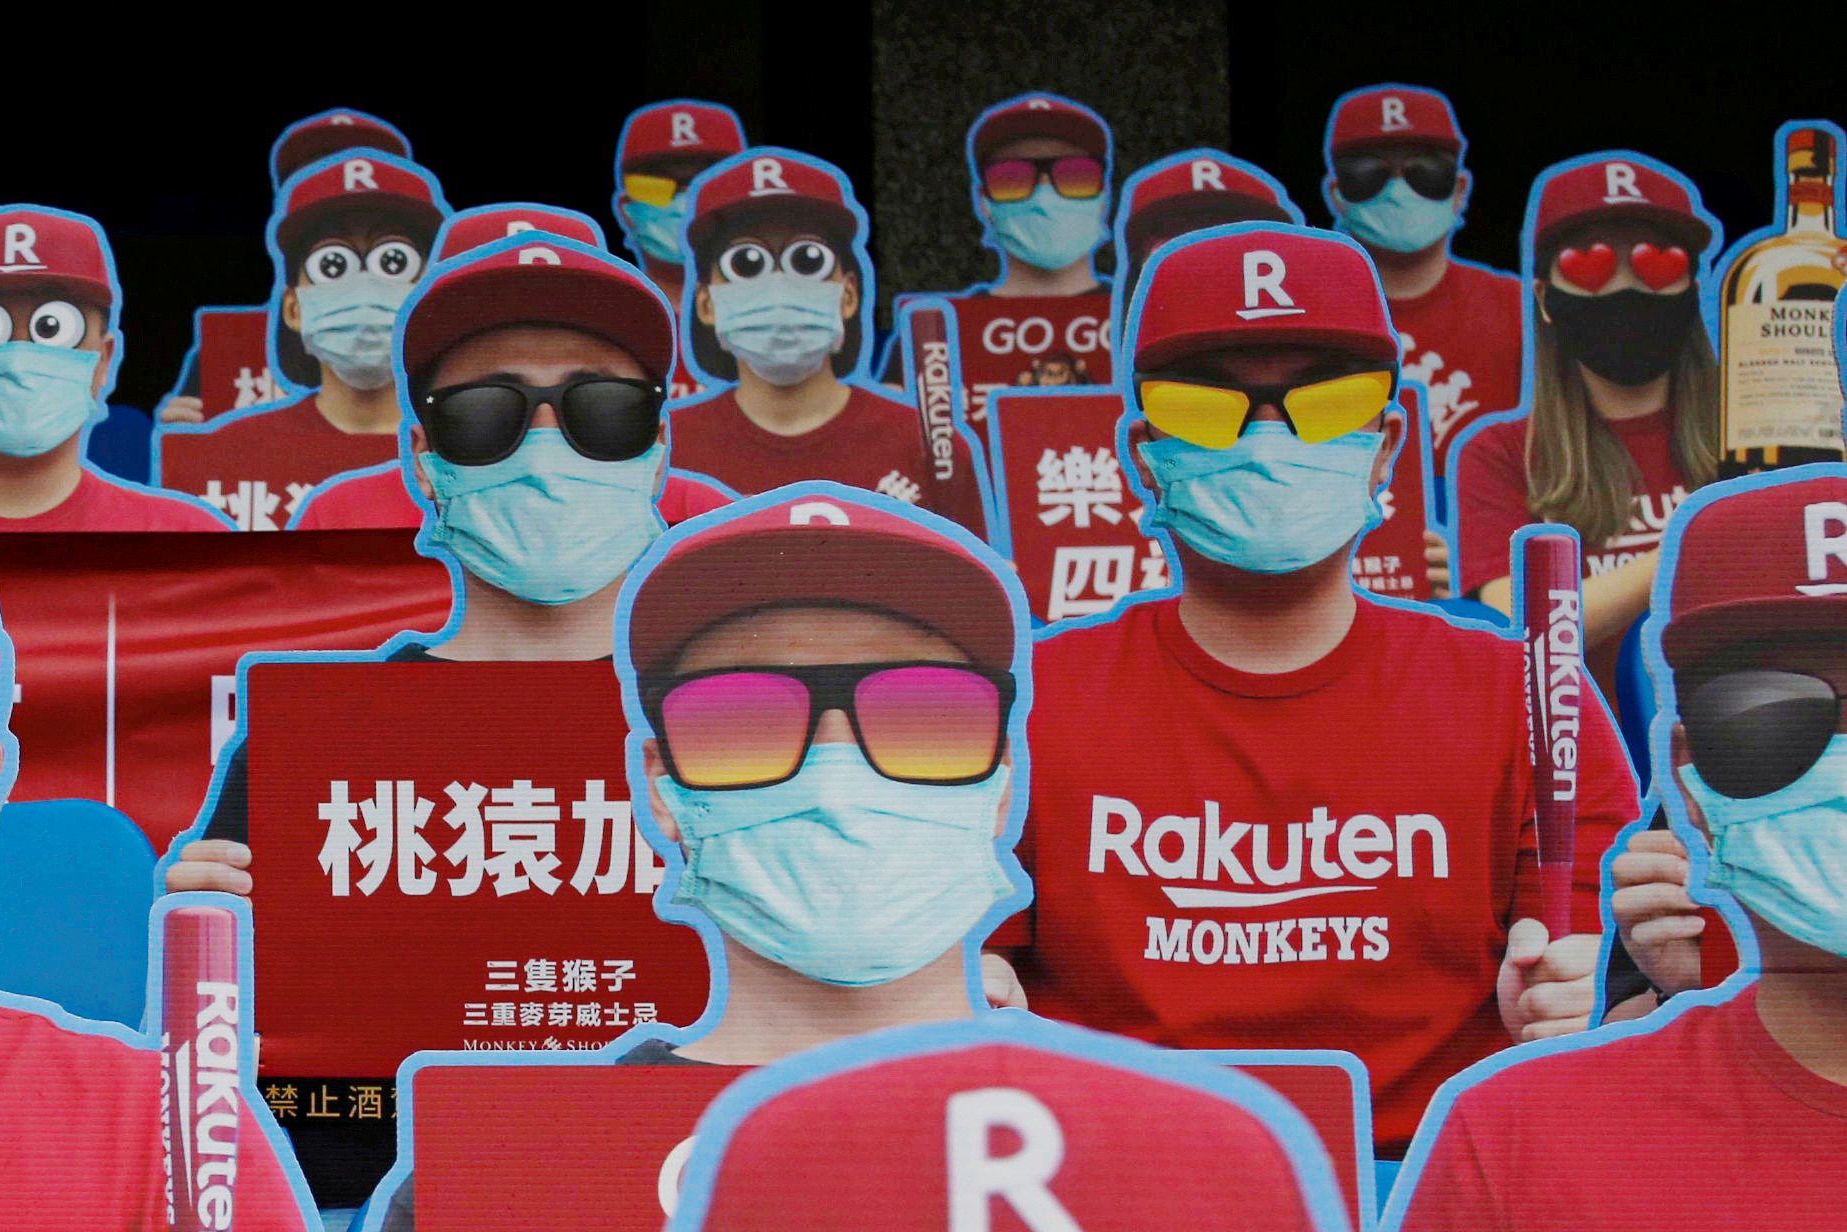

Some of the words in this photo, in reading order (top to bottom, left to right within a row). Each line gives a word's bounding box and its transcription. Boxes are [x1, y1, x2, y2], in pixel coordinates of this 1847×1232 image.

[671, 112, 700, 143] R
[1382, 97, 1408, 128] R
[344, 158, 379, 191] R
[752, 157, 789, 191] R
[1188, 157, 1226, 191] R
[1605, 163, 1642, 197] R
[4, 223, 41, 264] R
[1243, 249, 1295, 308] R
[982, 317, 1054, 354] GO
[1548, 590, 1583, 801] Rakuten
[1088, 794, 1450, 886] Rakuten
[1143, 916, 1391, 965] MONKEYS
[485, 958, 637, 993] 三隻猴子
[265, 1084, 397, 1120] 禁止酒
